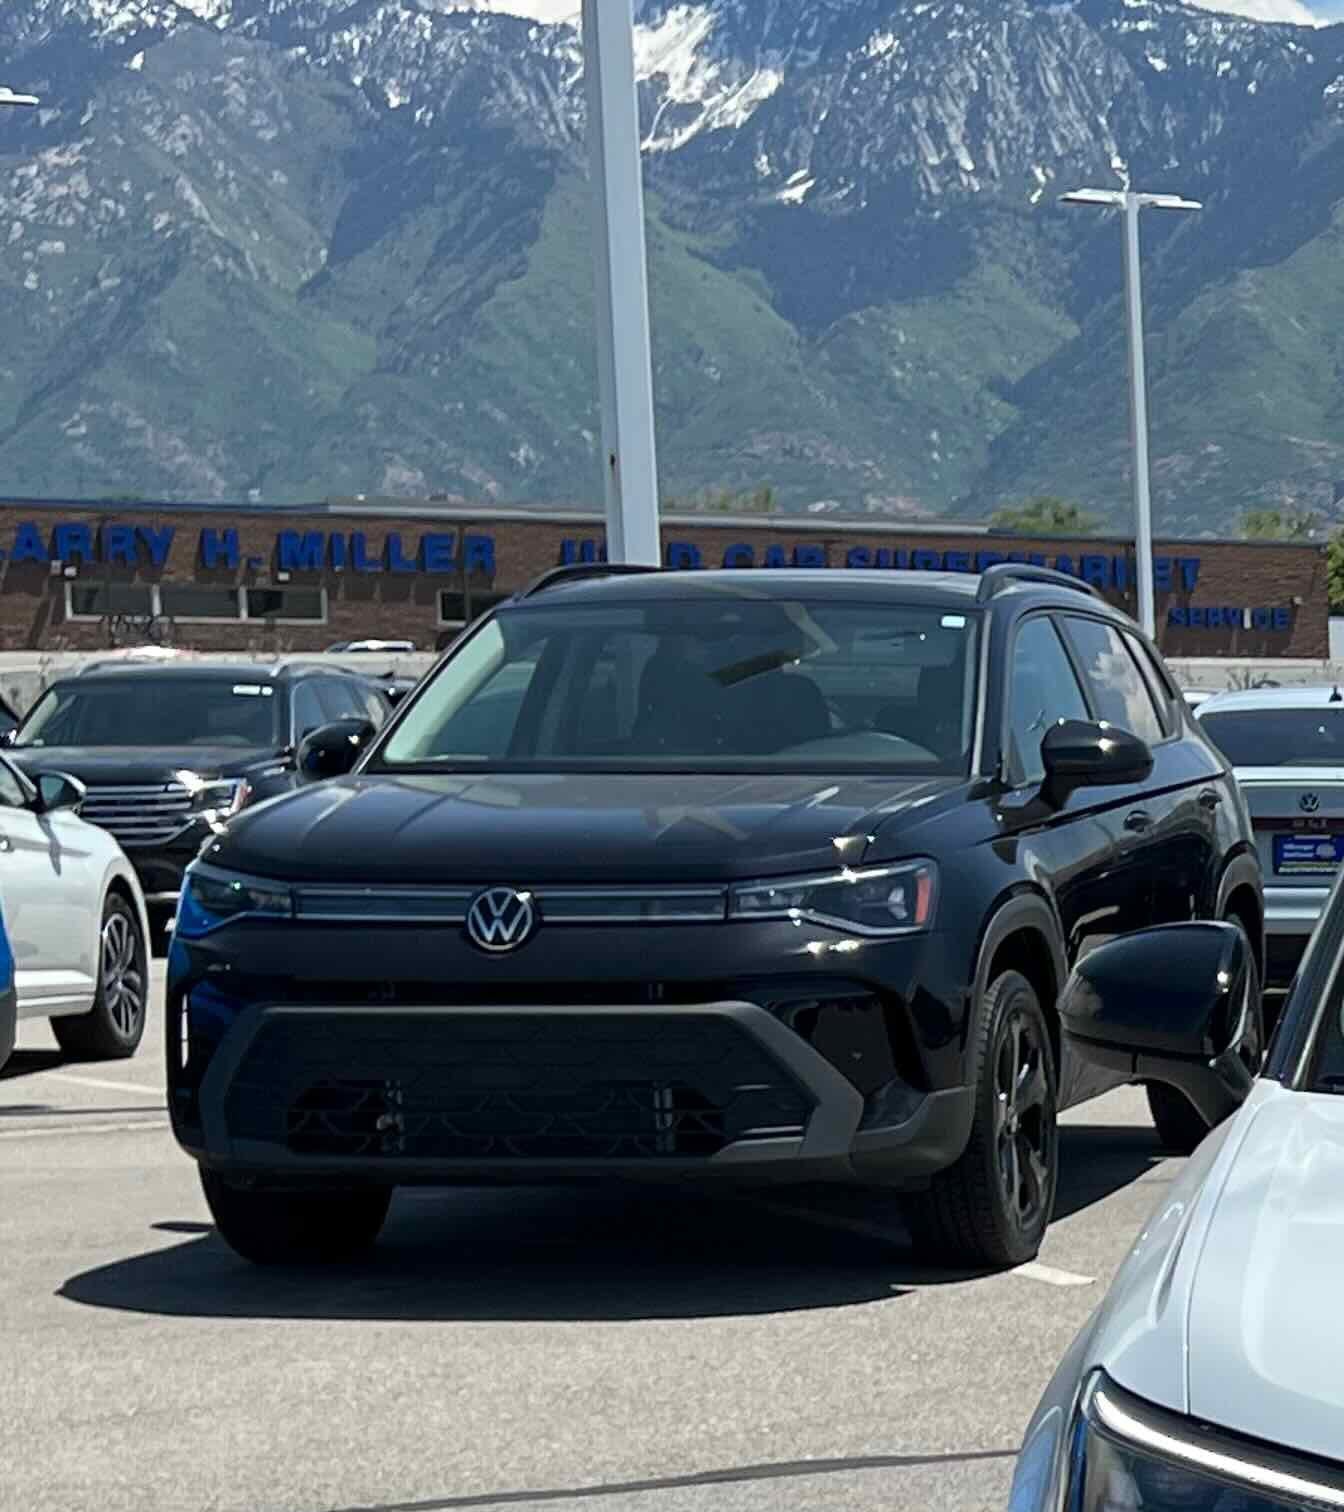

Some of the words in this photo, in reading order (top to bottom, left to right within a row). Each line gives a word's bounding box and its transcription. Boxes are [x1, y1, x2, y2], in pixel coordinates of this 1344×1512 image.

[0, 521, 176, 567] ARRY
[277, 528, 495, 573] MILLER
[723, 543, 829, 568] CAR
[1169, 607, 1290, 628] SERVICE
